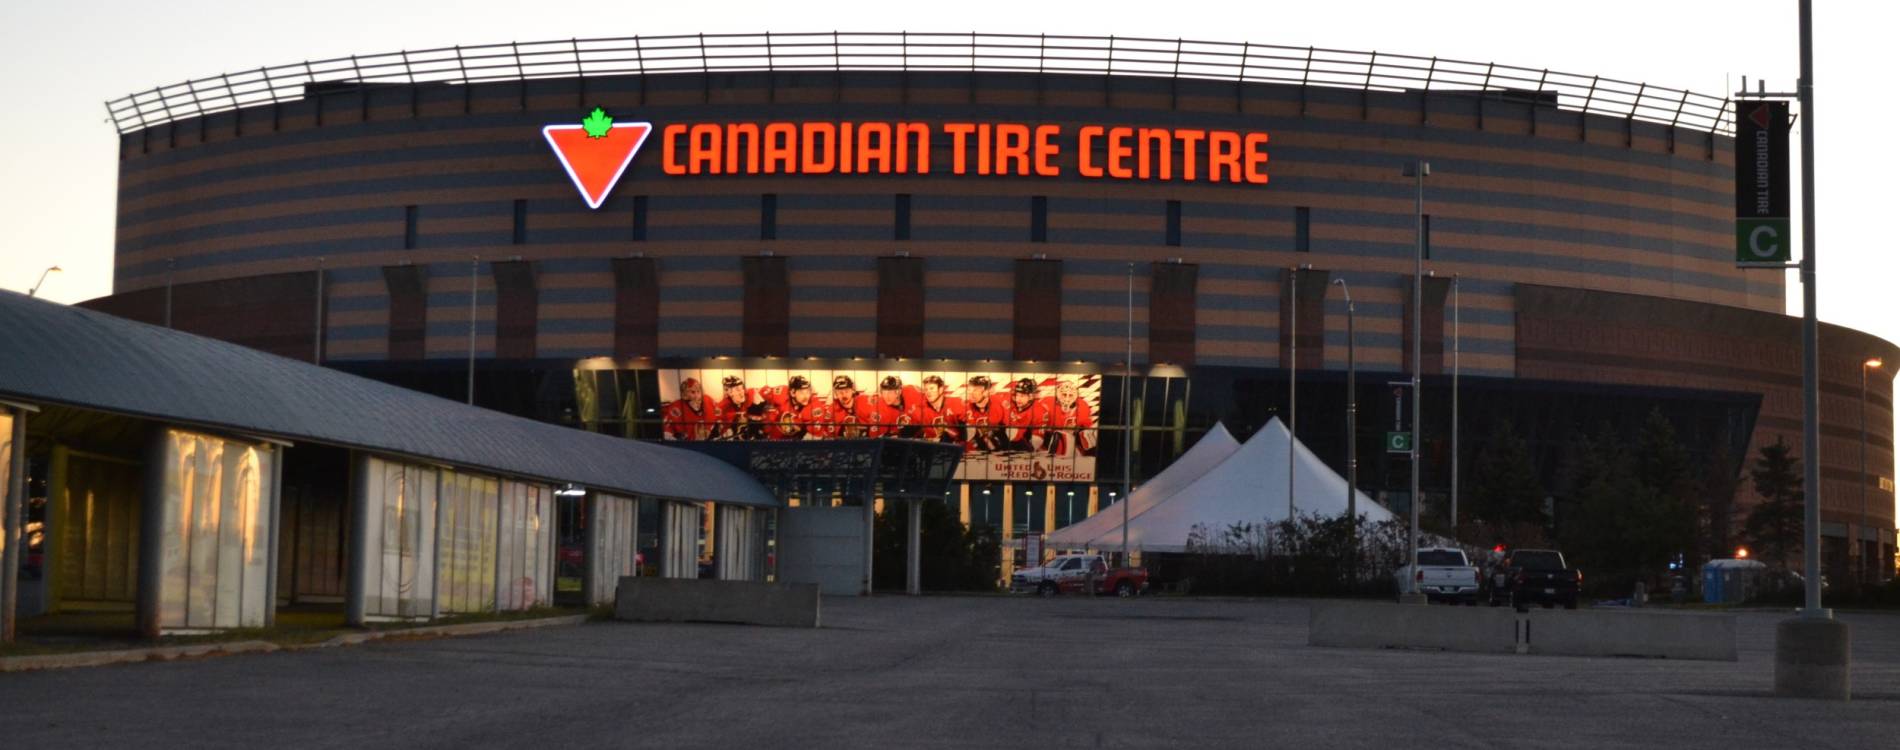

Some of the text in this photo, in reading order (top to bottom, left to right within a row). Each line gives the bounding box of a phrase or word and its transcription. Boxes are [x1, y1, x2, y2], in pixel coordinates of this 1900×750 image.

[662, 122, 1269, 184] CANADIAN TIRE CENTRE
[1756, 130, 1769, 215] CANADIAN TIRE
[1750, 225, 1778, 258] C
[1392, 435, 1404, 449] C
[995, 463, 1031, 472] UNITED
[1047, 463, 1072, 472] UNIS
[1008, 471, 1029, 479] RED
[1056, 471, 1092, 480] ROUGE
